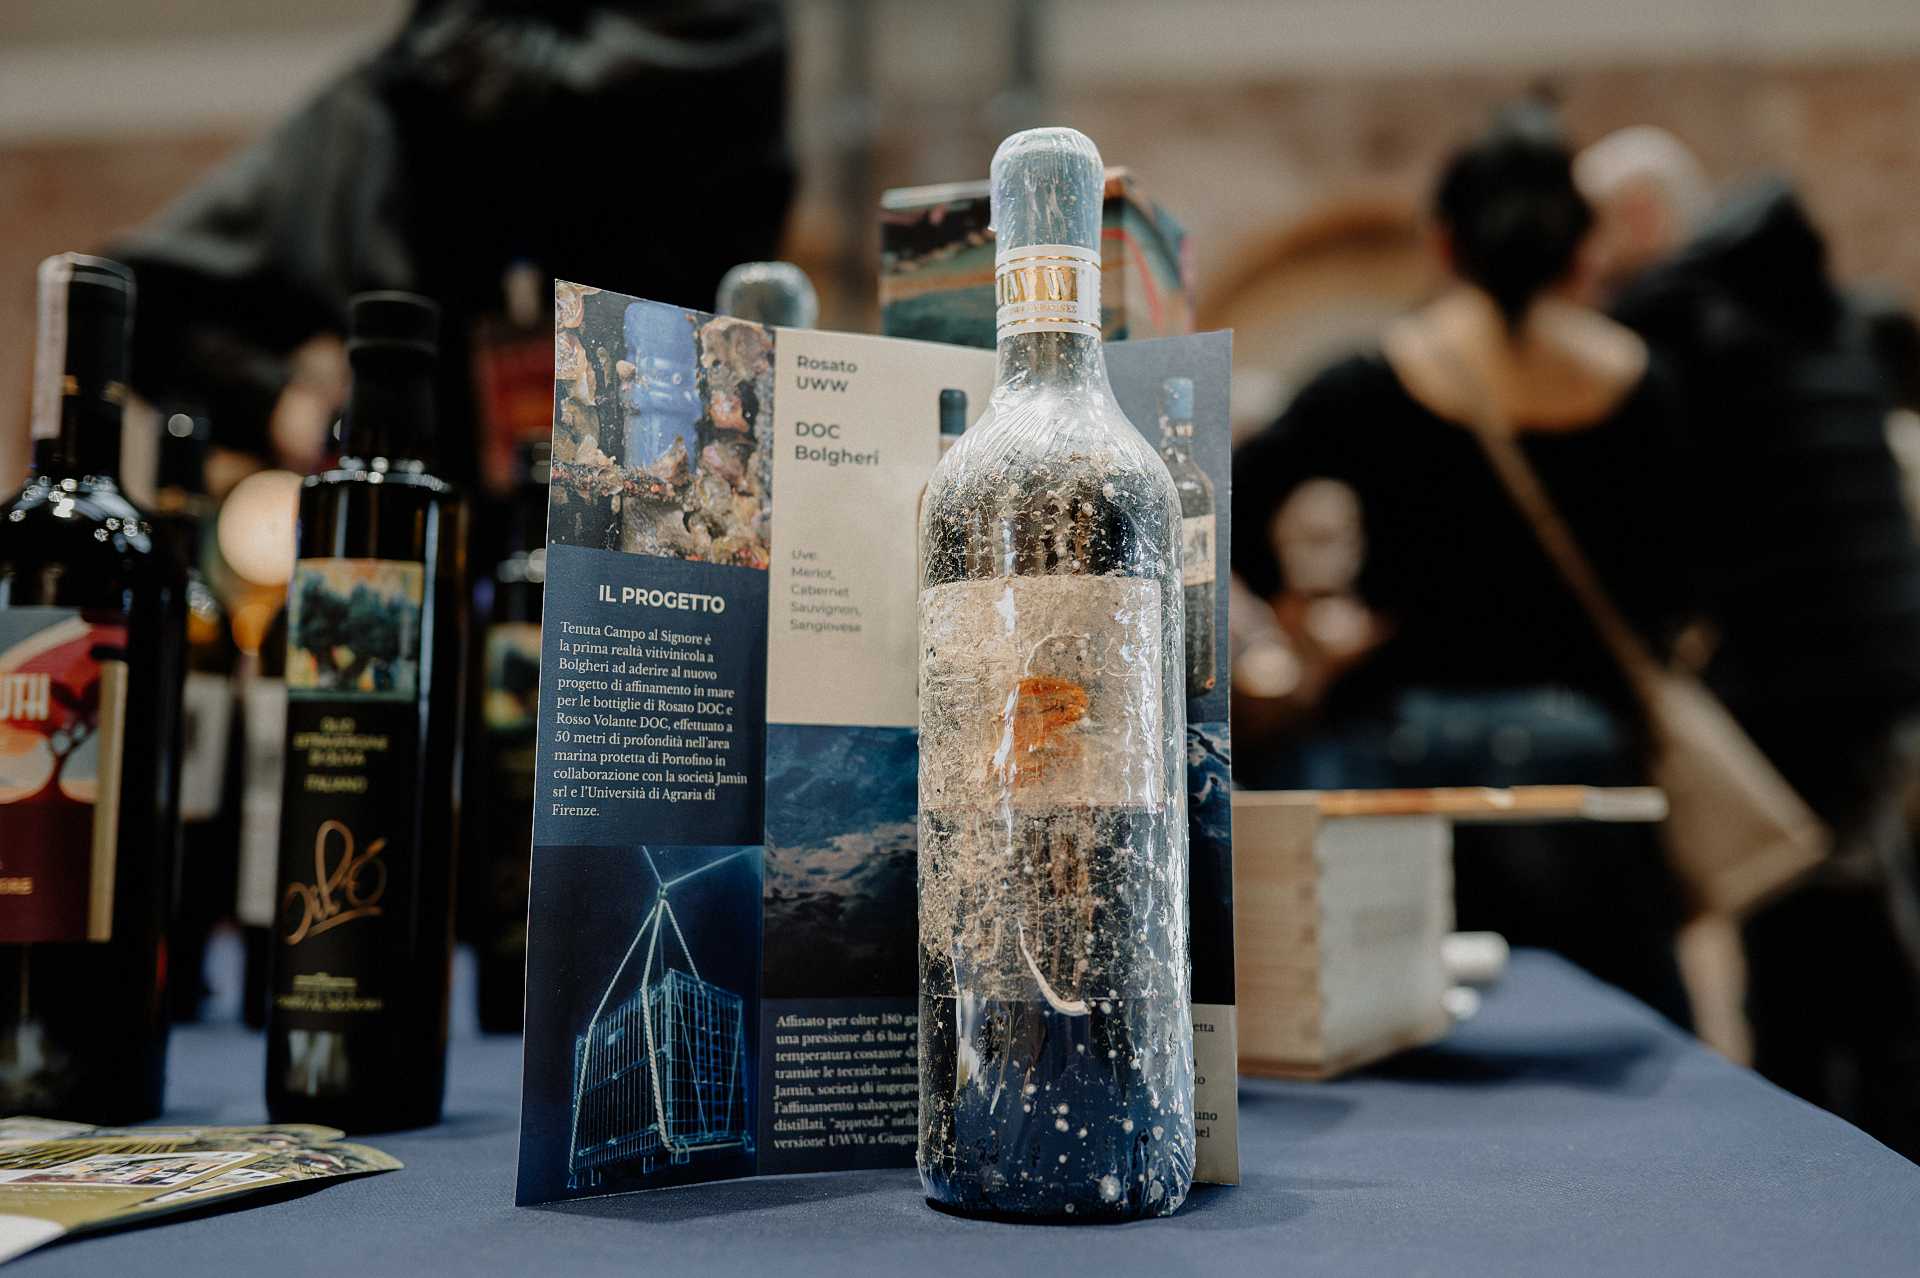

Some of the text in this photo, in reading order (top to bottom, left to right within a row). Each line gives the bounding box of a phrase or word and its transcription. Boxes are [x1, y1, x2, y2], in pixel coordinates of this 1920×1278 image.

[797, 355, 857, 373] Rosato
[796, 376, 848, 392] UWW
[795, 422, 840, 439] DOC
[795, 445, 879, 466] Bolgheri
[792, 584, 849, 597] Cabernet
[599, 585, 725, 613] IL PROGETTO
[561, 621, 711, 645] Tenuta Campo al Signore è
[791, 619, 862, 632] Sangiovese
[560, 640, 713, 663] la prima realtà vitivinicola a
[559, 658, 717, 680] Bolgheri ad aderire al nuovo
[558, 677, 735, 699] progetto di affinamento in mare
[557, 696, 733, 715] per le bottiglie di Rosato DOC e
[556, 713, 732, 732] Rosso Volante DOC, effettuato a
[555, 731, 730, 749] 50 metri di profondità nell'area
[554, 750, 725, 766] marina protetta di Portofino in
[554, 768, 639, 781] collaborazione
[642, 772, 662, 782] con
[666, 772, 675, 782] la
[678, 773, 714, 783] società
[552, 786, 715, 801] srl e l'Università di Agraria di
[552, 804, 599, 816] Firenze.
[776, 1014, 824, 1027] Affinato
[827, 1017, 847, 1028] per
[1193, 1024, 1214, 1032] etta
[776, 1036, 799, 1044] una
[802, 1032, 859, 1046] pressione
[863, 1030, 875, 1041] di
[775, 1050, 850, 1064] temperatura
[775, 1069, 820, 1079] tramite
[823, 1066, 834, 1077] le
[861, 1081, 873, 1093] di
[774, 1136, 826, 1148] versione
